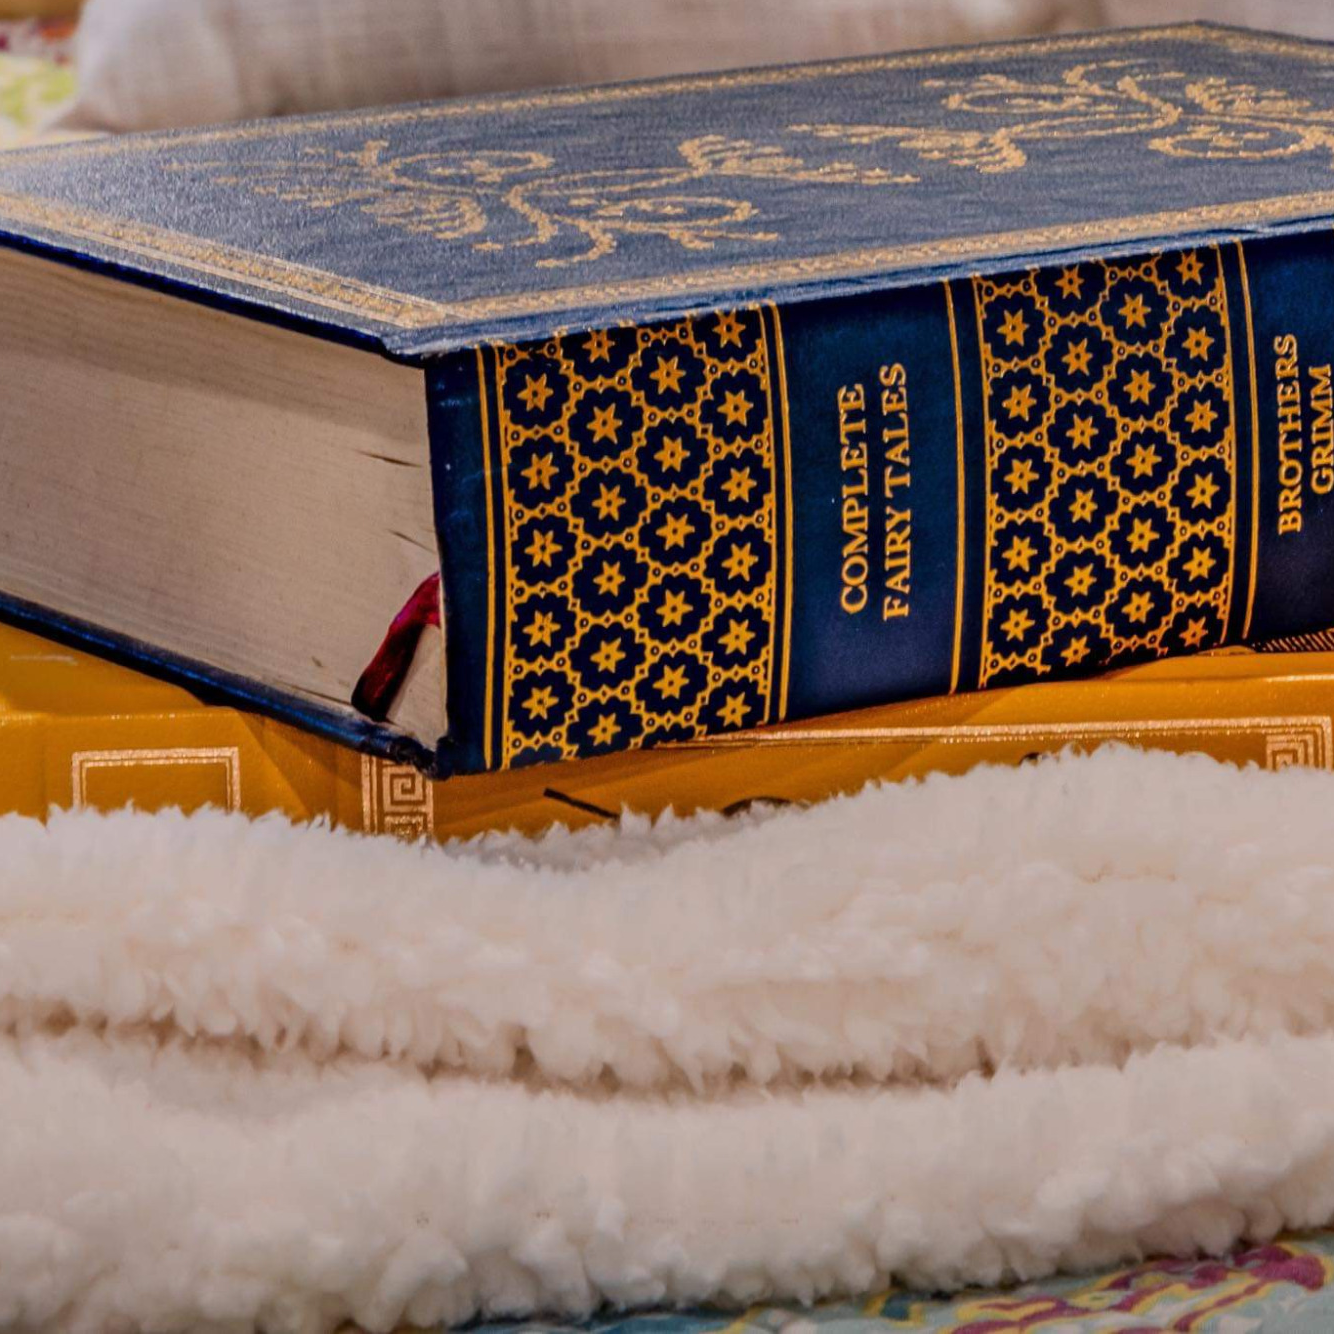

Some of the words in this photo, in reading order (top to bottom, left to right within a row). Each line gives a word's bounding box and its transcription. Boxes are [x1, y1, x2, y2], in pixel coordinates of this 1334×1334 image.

[879, 363, 911, 498] TALES
[1273, 333, 1304, 536] BROTHERS
[1308, 363, 1334, 496] GRIMM
[837, 383, 869, 614] COMPLETE
[883, 506, 911, 621] FAIRY
